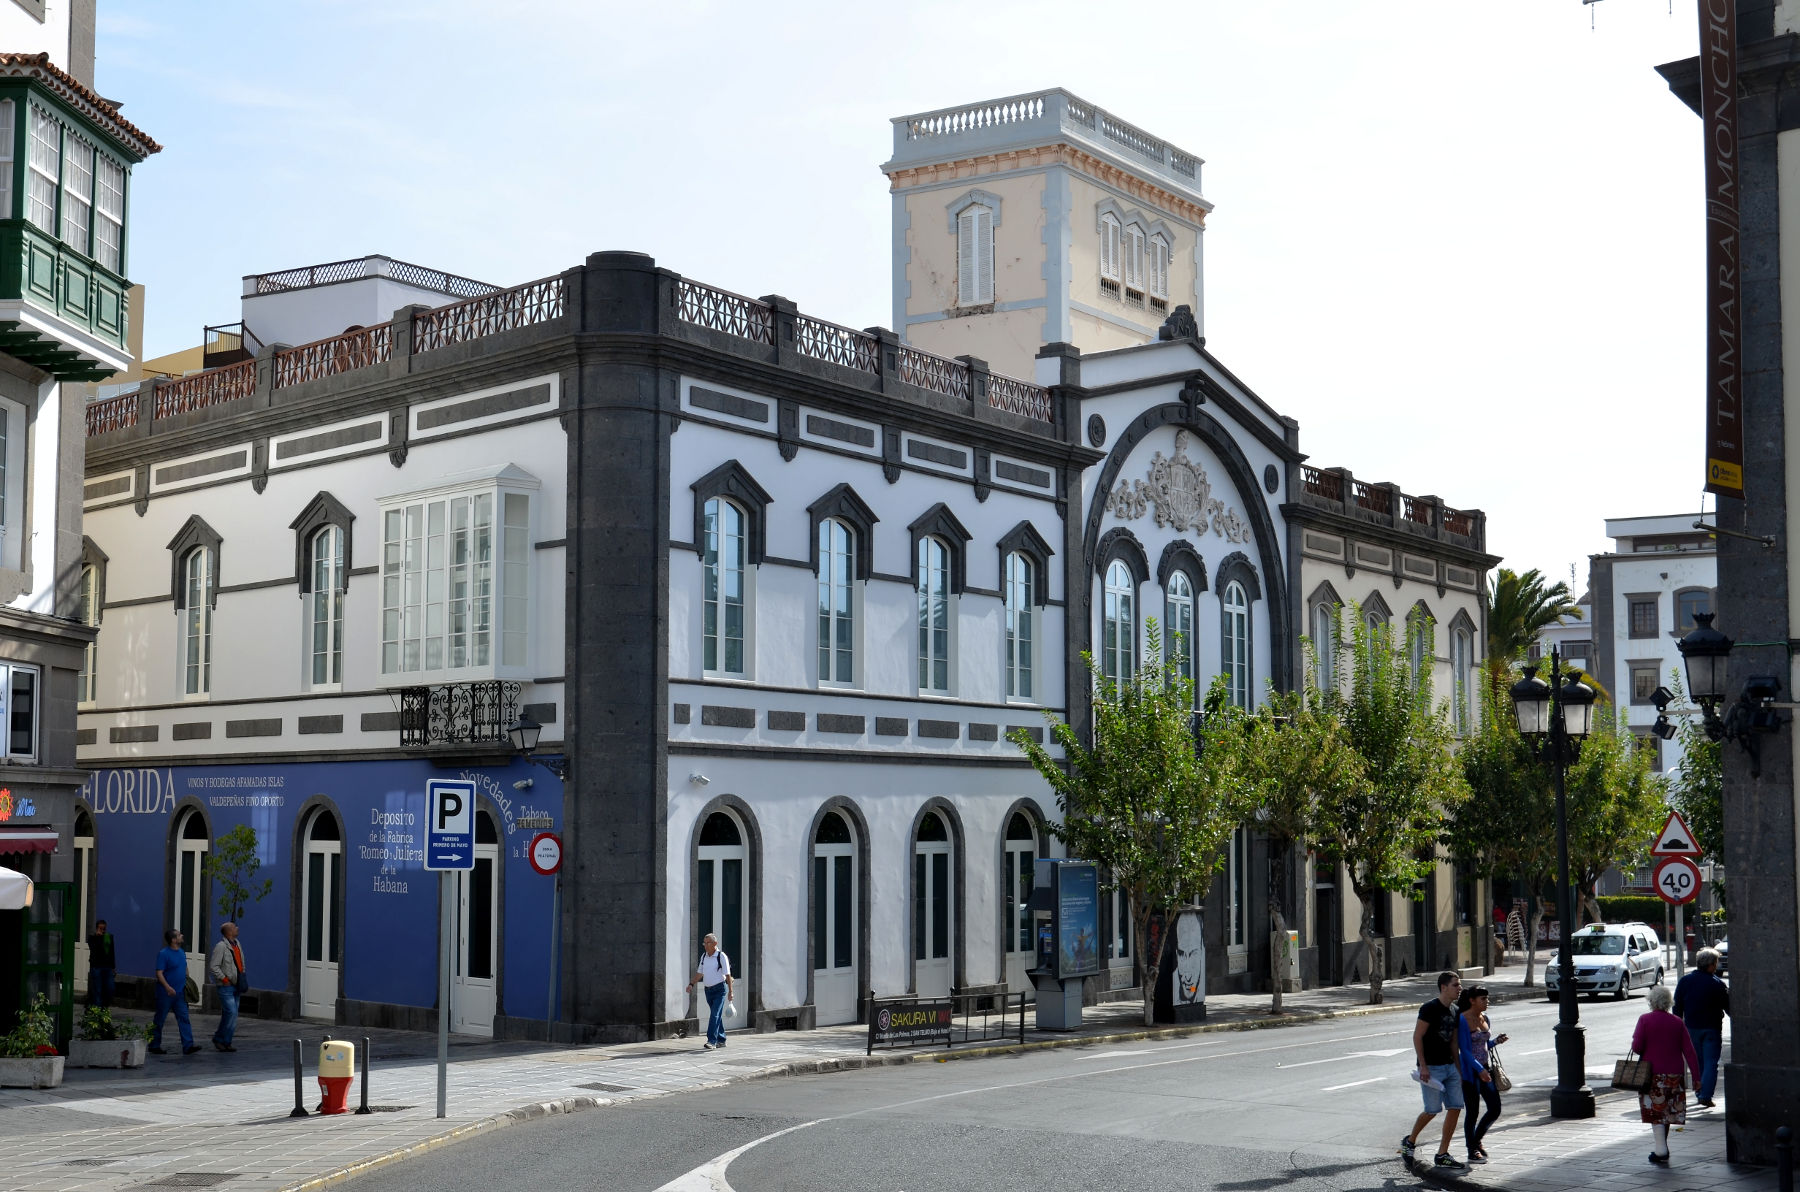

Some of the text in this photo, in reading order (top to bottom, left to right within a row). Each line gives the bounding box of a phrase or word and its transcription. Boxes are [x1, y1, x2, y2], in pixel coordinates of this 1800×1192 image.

[1717, 235, 1735, 425] TAMARA
[209, 777, 236, 788] BODEGAS
[260, 796, 284, 807] OPORTO
[460, 769, 516, 835] Novedades
[439, 793, 463, 830] P
[521, 805, 549, 818] Tabaco
[369, 830, 414, 844] de la Fabrica
[513, 846, 519, 858] la
[380, 864, 396, 875] de la
[373, 876, 408, 894] Habana
[1662, 872, 1691, 889] 40
[890, 1011, 927, 1027] SAKURA
[928, 1010, 937, 1024] VI
